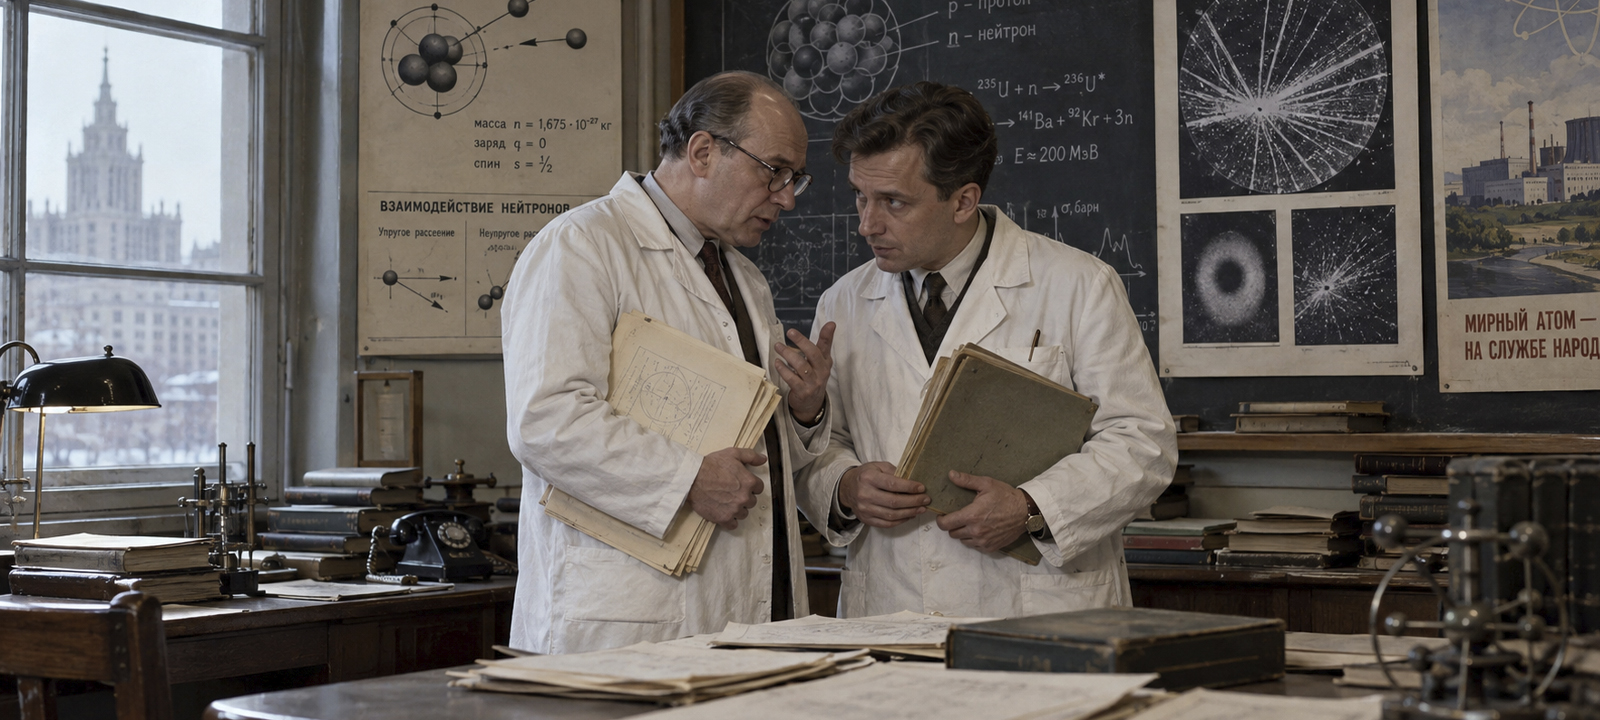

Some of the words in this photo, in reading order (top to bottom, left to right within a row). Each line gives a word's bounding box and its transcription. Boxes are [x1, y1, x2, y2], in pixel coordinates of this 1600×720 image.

[946, 31, 960, 48] n
[978, 23, 1036, 43] нейтрон
[1028, 83, 1038, 96] n
[474, 119, 507, 129] масса
[513, 120, 521, 130] n
[538, 118, 567, 132] 1,675
[600, 122, 612, 131] кг
[1114, 108, 1134, 126] 3n
[473, 139, 507, 151] заряд
[513, 140, 521, 153] q
[538, 137, 547, 149] 0
[1014, 147, 1025, 164] E
[1039, 145, 1066, 163] 200
[1068, 143, 1099, 161] МэВ
[473, 159, 501, 169] спин
[513, 160, 521, 170] s
[380, 198, 494, 215] ВЗАИМОДЕЙСТВИЕ
[501, 200, 570, 215] НЕЙТРОНОВ
[1074, 199, 1099, 217] барн
[378, 226, 411, 239] Упругое
[479, 227, 520, 240] Неупругое
[1465, 307, 1528, 334] МИРНЫЙ
[1536, 309, 1577, 331] АТОМ
[1464, 340, 1483, 361] НА
[1488, 338, 1548, 360] СЛУЖБЕ
[1553, 336, 1600, 361] НАРОД
